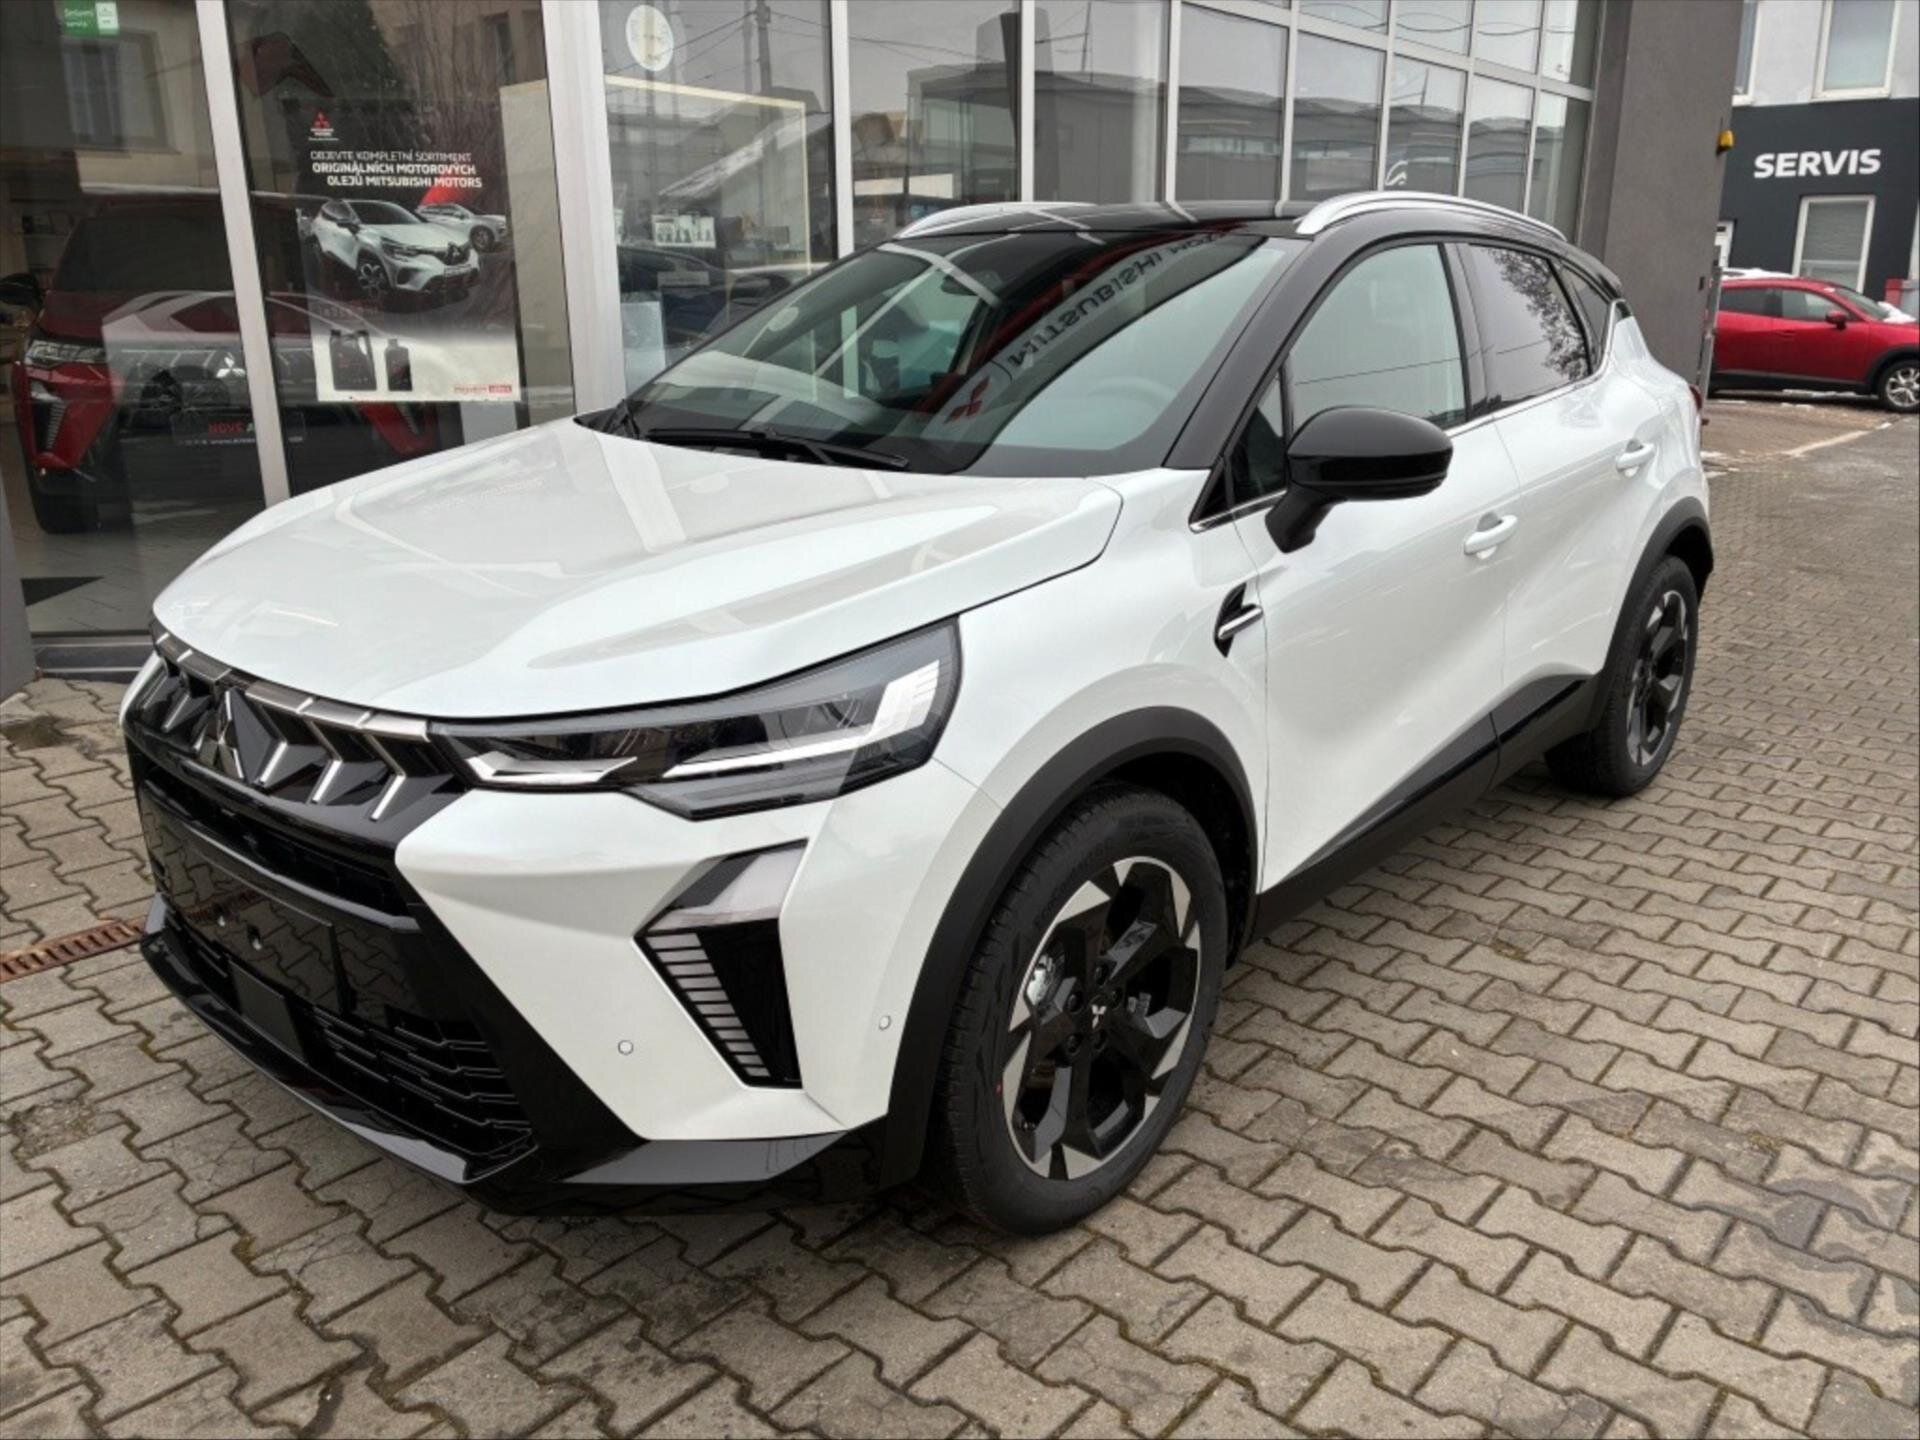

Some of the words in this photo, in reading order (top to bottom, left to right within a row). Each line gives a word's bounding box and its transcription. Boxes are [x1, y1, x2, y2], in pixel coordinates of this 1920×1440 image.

[310, 151, 353, 161] OBJEVTE
[356, 149, 413, 161] KOMPLETNÍ
[416, 152, 472, 162] SORTIMENT
[312, 161, 394, 174] ORIGINÁLNÍCH
[396, 162, 476, 175] MOTOROVÝCH
[1753, 148, 1881, 178] SERVIS
[327, 173, 363, 186] OLEJŮ
[366, 177, 432, 187] MITSUBISHI
[434, 177, 482, 188] MOTORS
